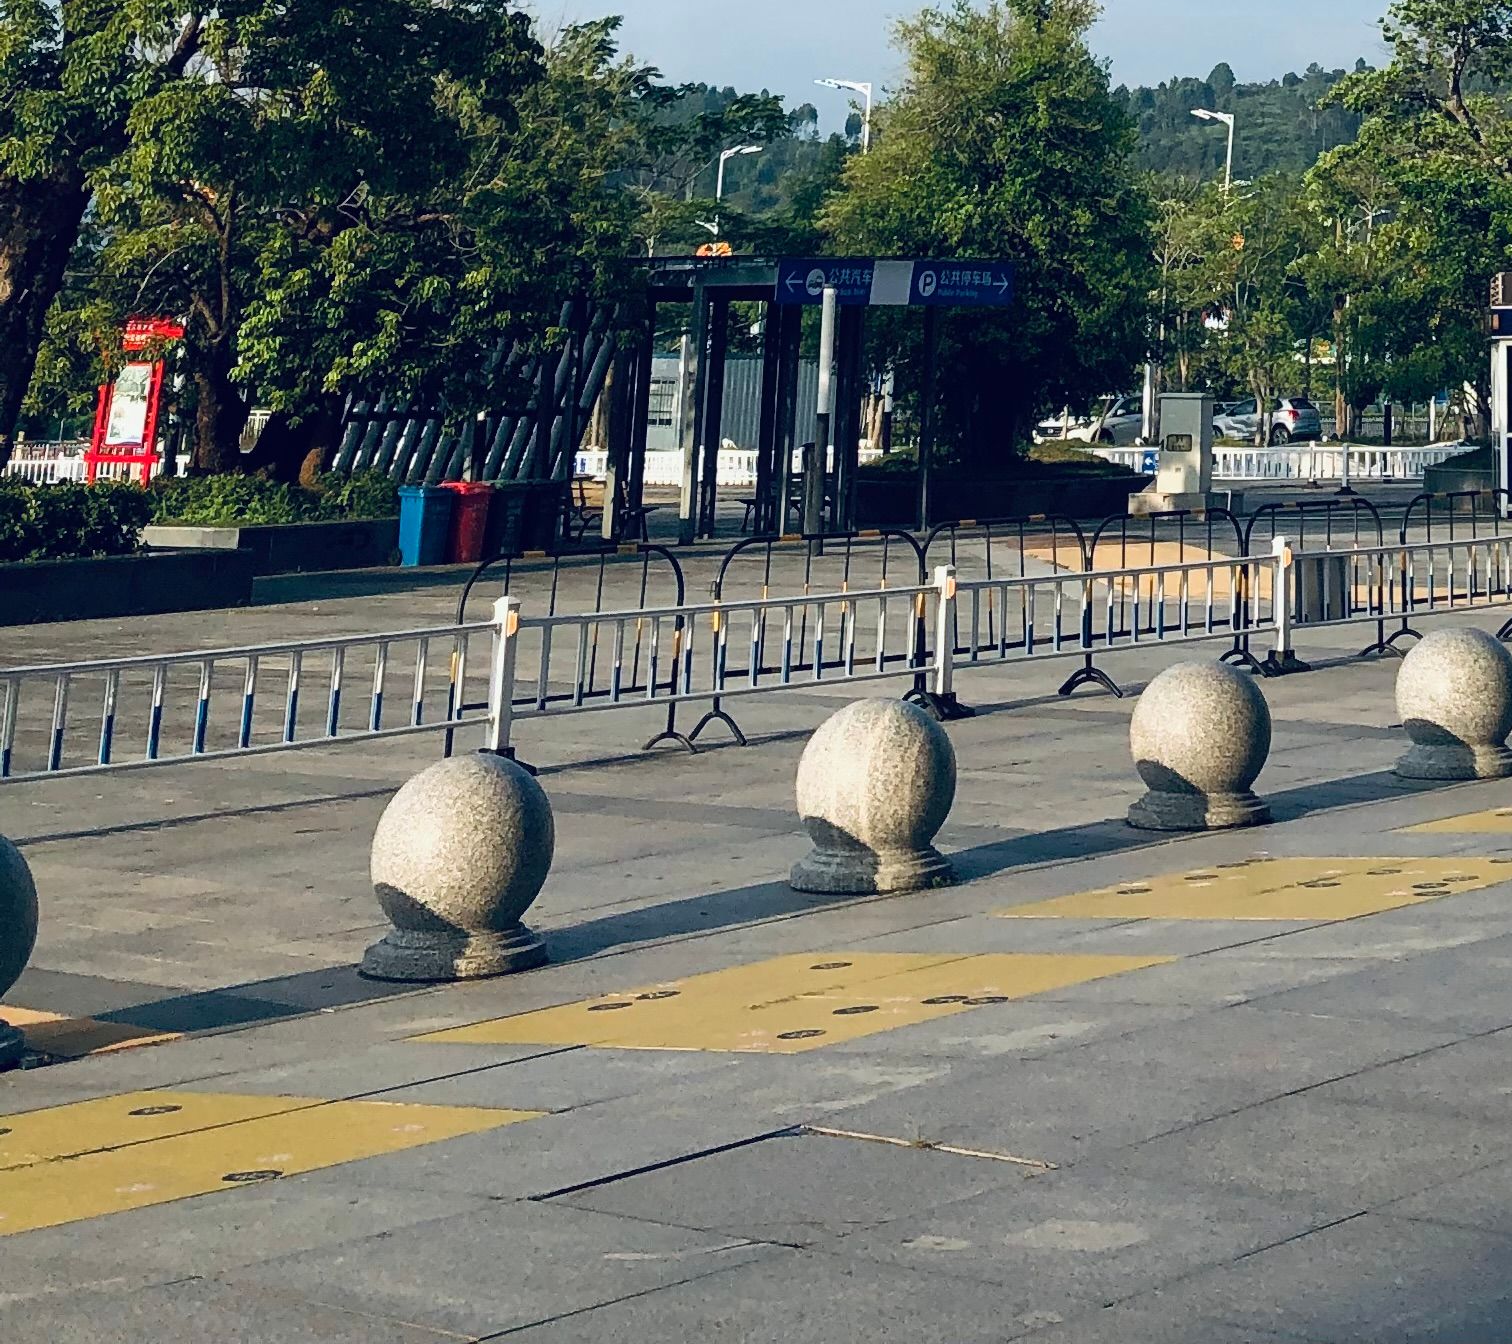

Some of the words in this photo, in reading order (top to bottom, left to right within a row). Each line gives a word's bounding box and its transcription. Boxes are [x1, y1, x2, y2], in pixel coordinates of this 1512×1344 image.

[940, 269, 991, 287] 公共停车场
